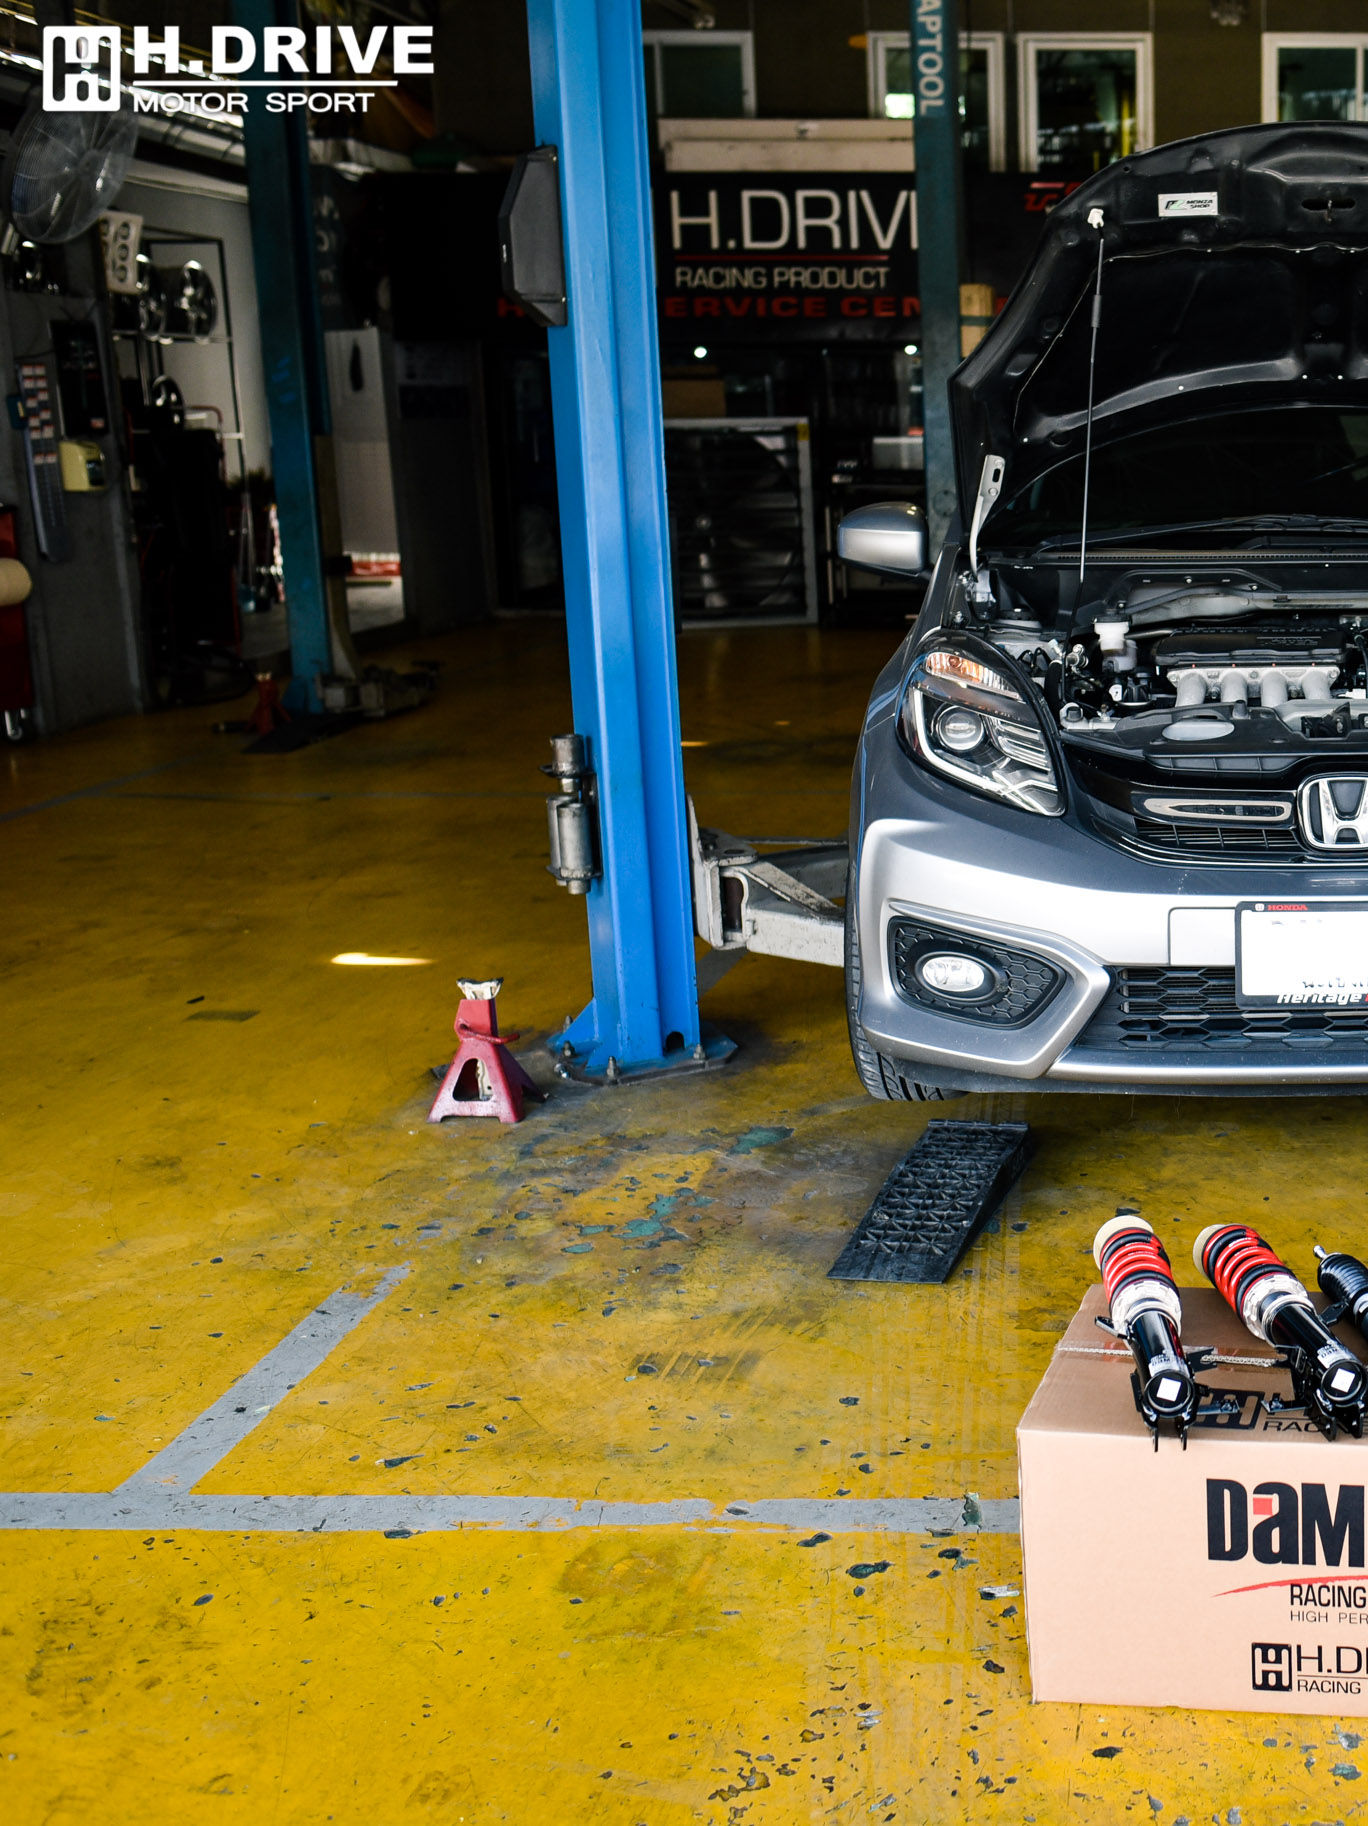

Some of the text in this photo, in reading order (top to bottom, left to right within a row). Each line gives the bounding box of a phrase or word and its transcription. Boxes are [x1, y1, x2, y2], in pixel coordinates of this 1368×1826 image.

[675, 266, 890, 290] RACING PRODUCT
[1276, 992, 1362, 1006] Heritage
[1290, 1584, 1366, 1608] RACING
[1290, 1610, 1329, 1623] HIGH
[1297, 1679, 1361, 1695] RACING
